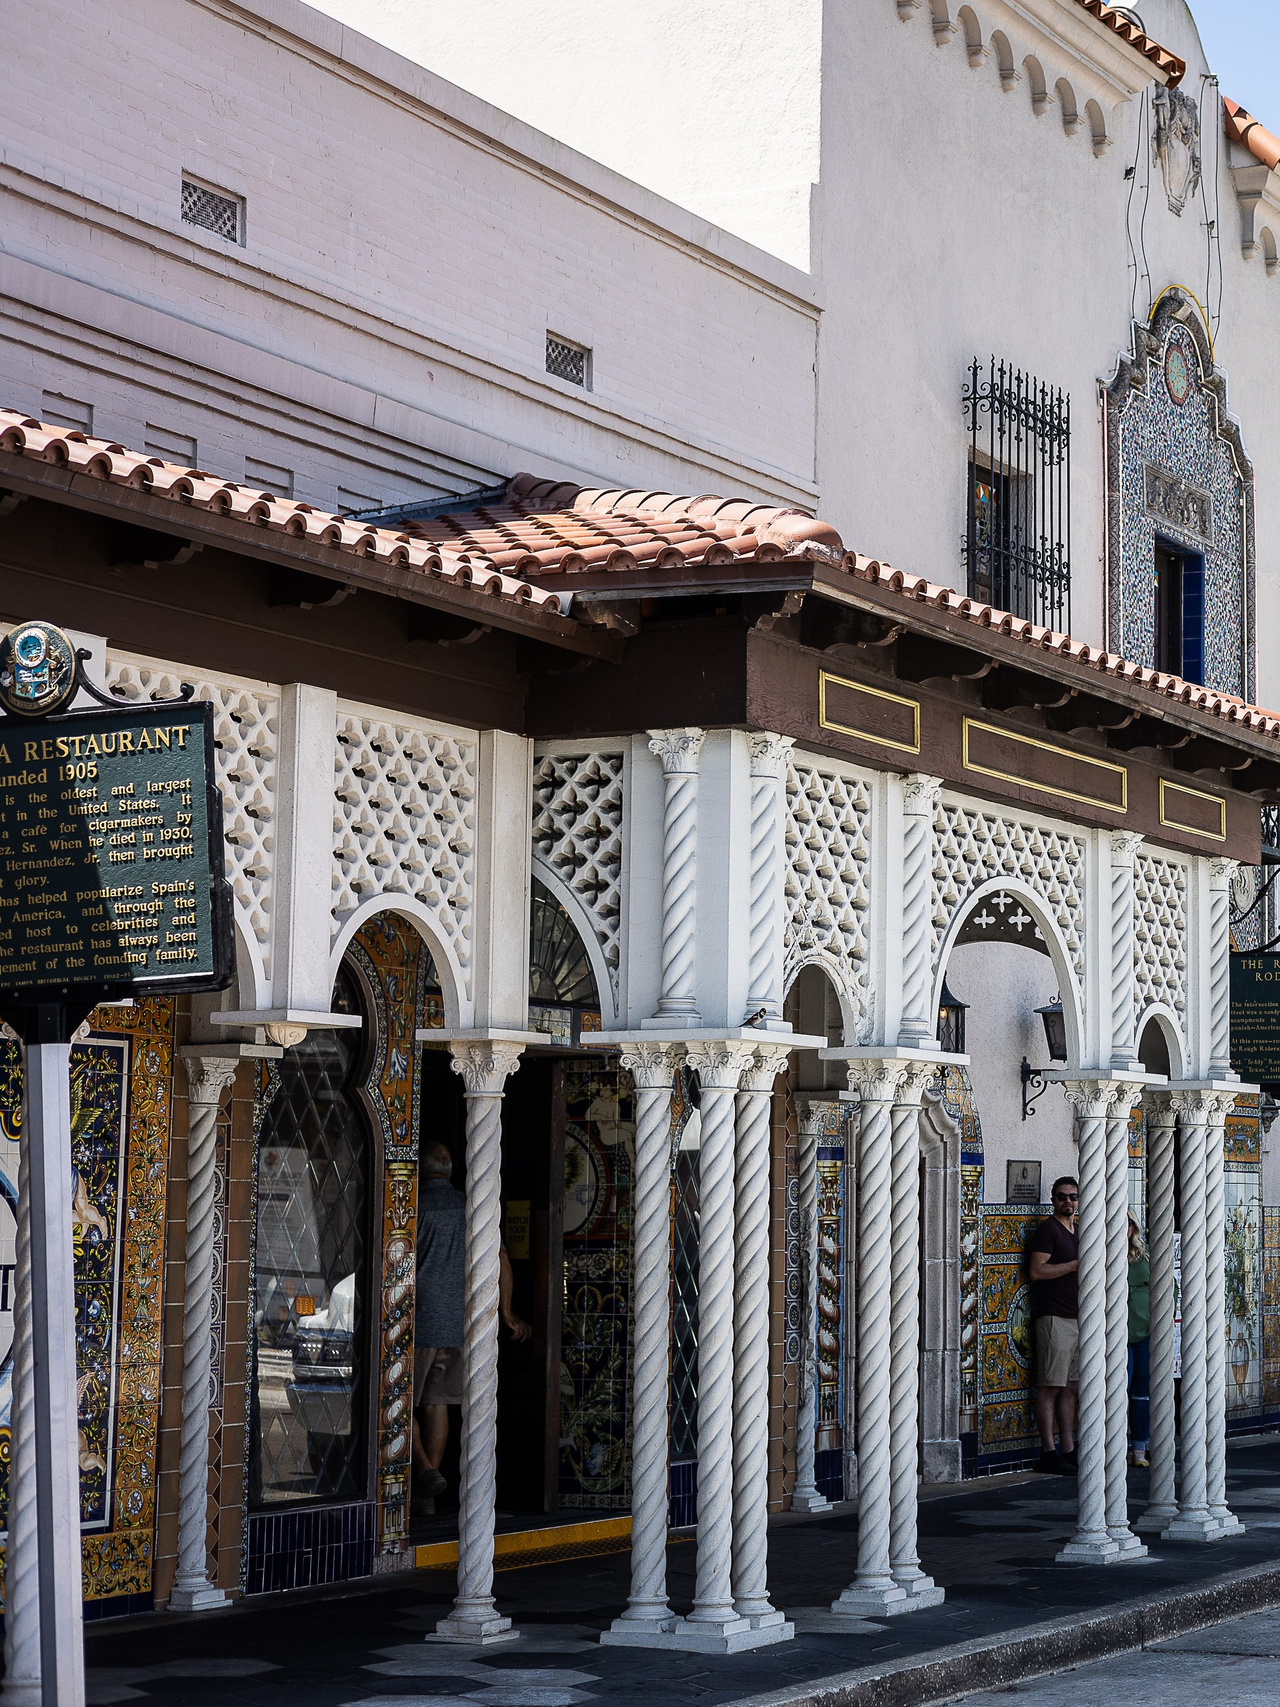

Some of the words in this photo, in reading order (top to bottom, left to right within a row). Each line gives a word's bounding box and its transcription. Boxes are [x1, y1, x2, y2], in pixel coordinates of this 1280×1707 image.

[24, 726, 189, 760] RESTAURANT
[59, 763, 97, 779] 1905
[6, 795, 14, 805] is
[29, 793, 47, 803] the
[61, 787, 97, 799] oldest
[111, 783, 134, 795] and
[147, 778, 190, 792] largest
[17, 811, 27, 820] in
[38, 808, 58, 818] the
[69, 802, 108, 814] United
[119, 799, 159, 811] States.
[181, 794, 191, 805] It
[21, 825, 47, 836] café
[60, 823, 77, 833] for
[89, 816, 163, 832] cigarmakers
[177, 811, 192, 824] by
[22, 842, 37, 852] Sr.
[50, 840, 82, 850] When
[89, 836, 104, 846] he
[109, 832, 136, 844] died
[142, 831, 153, 842] in
[84, 853, 100, 862] Jr.
[108, 851, 134, 861] then
[143, 844, 193, 860] brought
[15, 876, 49, 889] glory.
[28, 891, 67, 905] helped
[76, 885, 143, 902] popularize
[152, 880, 194, 895] Spain's
[82, 905, 103, 916] and
[114, 899, 163, 913] through
[174, 897, 197, 908] the
[26, 926, 51, 937] host
[66, 925, 78, 934] to
[92, 917, 158, 931] celebrities
[172, 912, 196, 925] and
[21, 941, 83, 954] restaurant
[91, 939, 111, 949] has
[119, 935, 158, 946] always
[165, 930, 196, 942] been
[46, 958, 58, 969] of
[66, 957, 85, 967] the
[94, 952, 147, 965] founding
[156, 947, 197, 963] family.
[1241, 960, 1263, 969] THE
